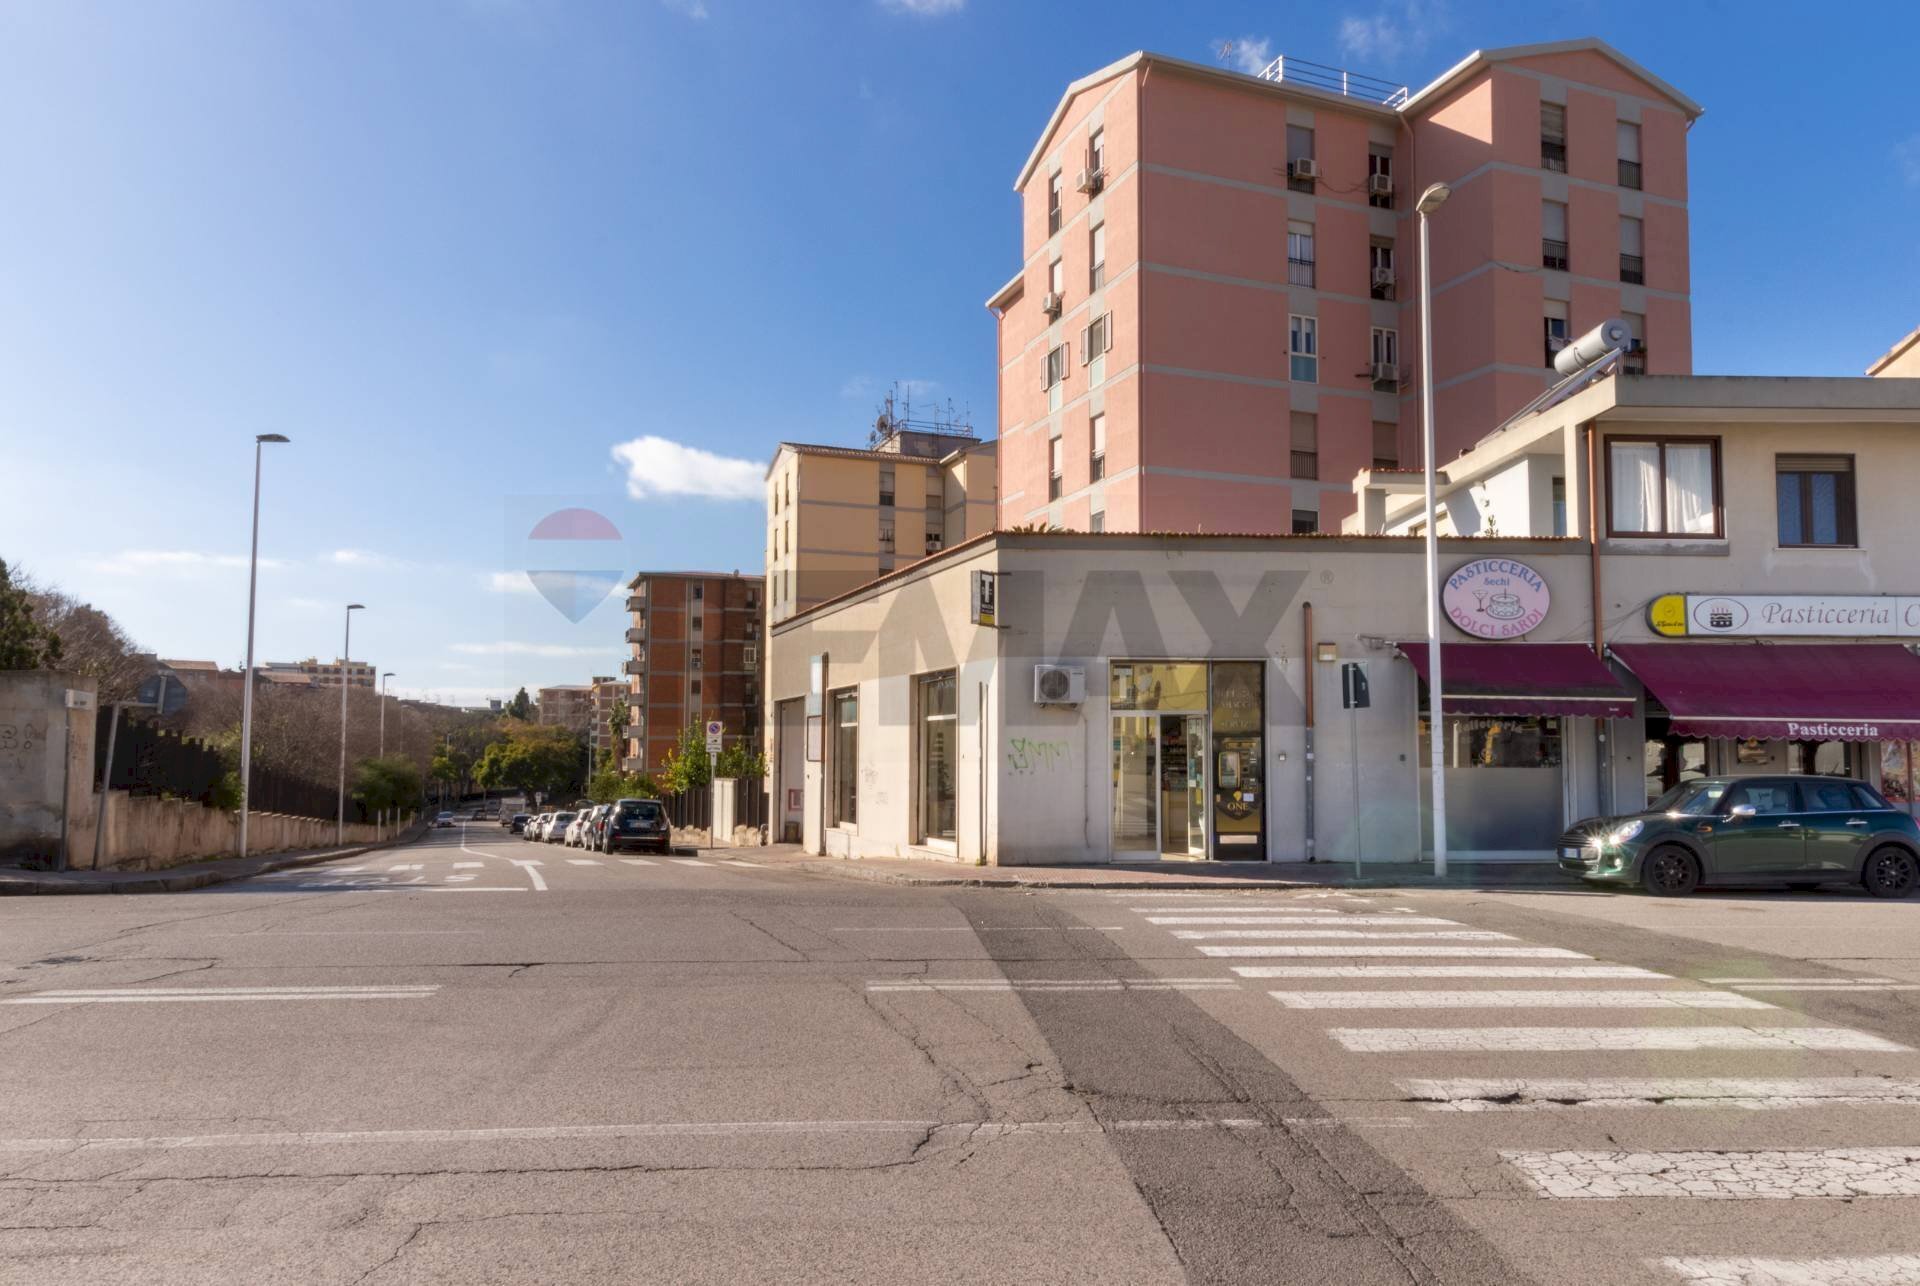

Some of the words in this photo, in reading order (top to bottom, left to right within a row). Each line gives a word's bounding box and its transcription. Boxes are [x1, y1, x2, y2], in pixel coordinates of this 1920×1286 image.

[1449, 560, 1542, 592] PASTICCERIA
[1450, 607, 1496, 636] DOLCI
[1502, 608, 1543, 636] SARDI
[1762, 601, 1890, 625] Pasticceria
[1787, 722, 1879, 736] Pasticceria
[1226, 801, 1249, 812] ONE
